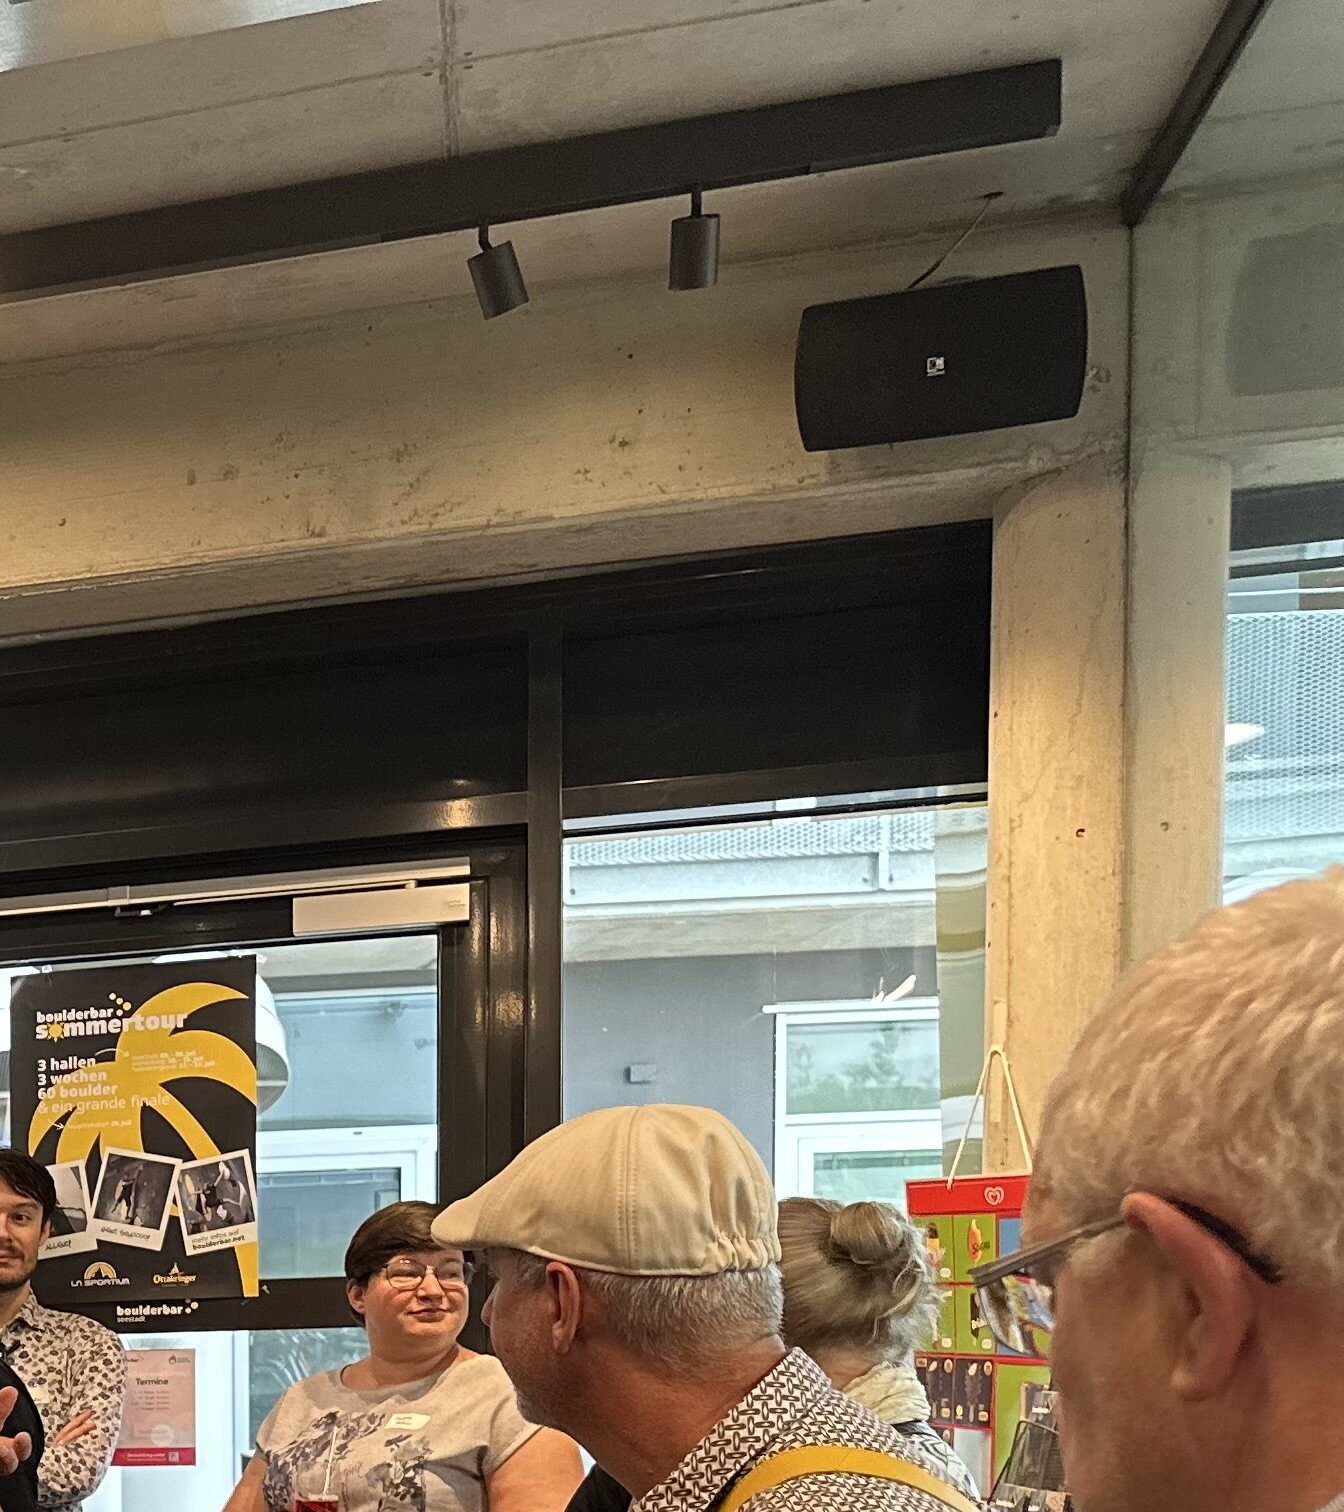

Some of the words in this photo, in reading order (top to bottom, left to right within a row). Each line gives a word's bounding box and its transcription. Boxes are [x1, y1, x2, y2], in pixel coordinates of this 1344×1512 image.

[36, 1007, 114, 1024] boulderbar
[37, 1059, 47, 1072] 3
[50, 1055, 97, 1071] hallen
[37, 1073, 47, 1086] 3
[50, 1070, 108, 1085] wochen
[37, 1086, 56, 1100] 60
[59, 1083, 119, 1099] boulder
[51, 1099, 76, 1113] ein
[76, 1096, 127, 1115] grande
[130, 1093, 170, 1109] finale
[192, 1233, 246, 1251] boulderbar.net
[83, 1277, 131, 1288] SPORTIVA
[116, 1304, 184, 1317] boulderbar
